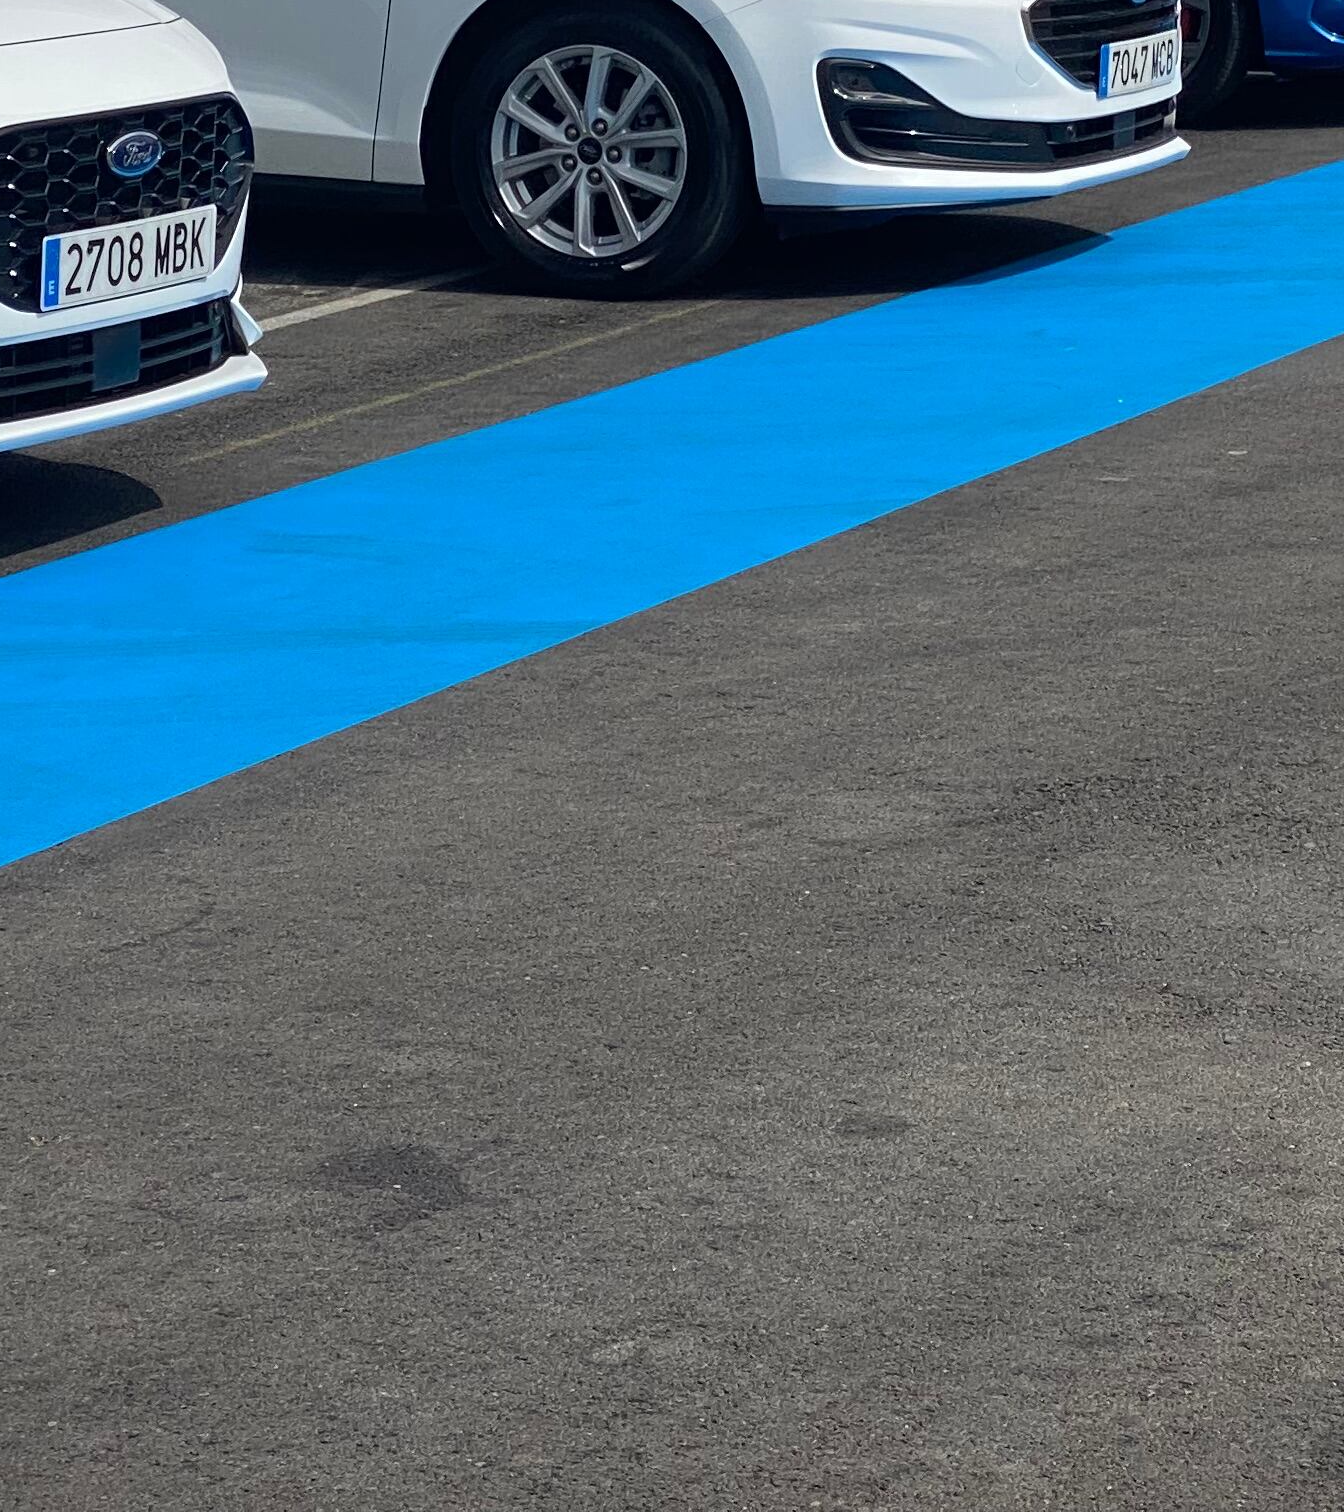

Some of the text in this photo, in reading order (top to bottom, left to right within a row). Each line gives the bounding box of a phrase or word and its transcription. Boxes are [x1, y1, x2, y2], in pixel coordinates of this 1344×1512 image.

[1110, 38, 1174, 89] 7047 MCB
[64, 217, 207, 296] 2708 MBK
